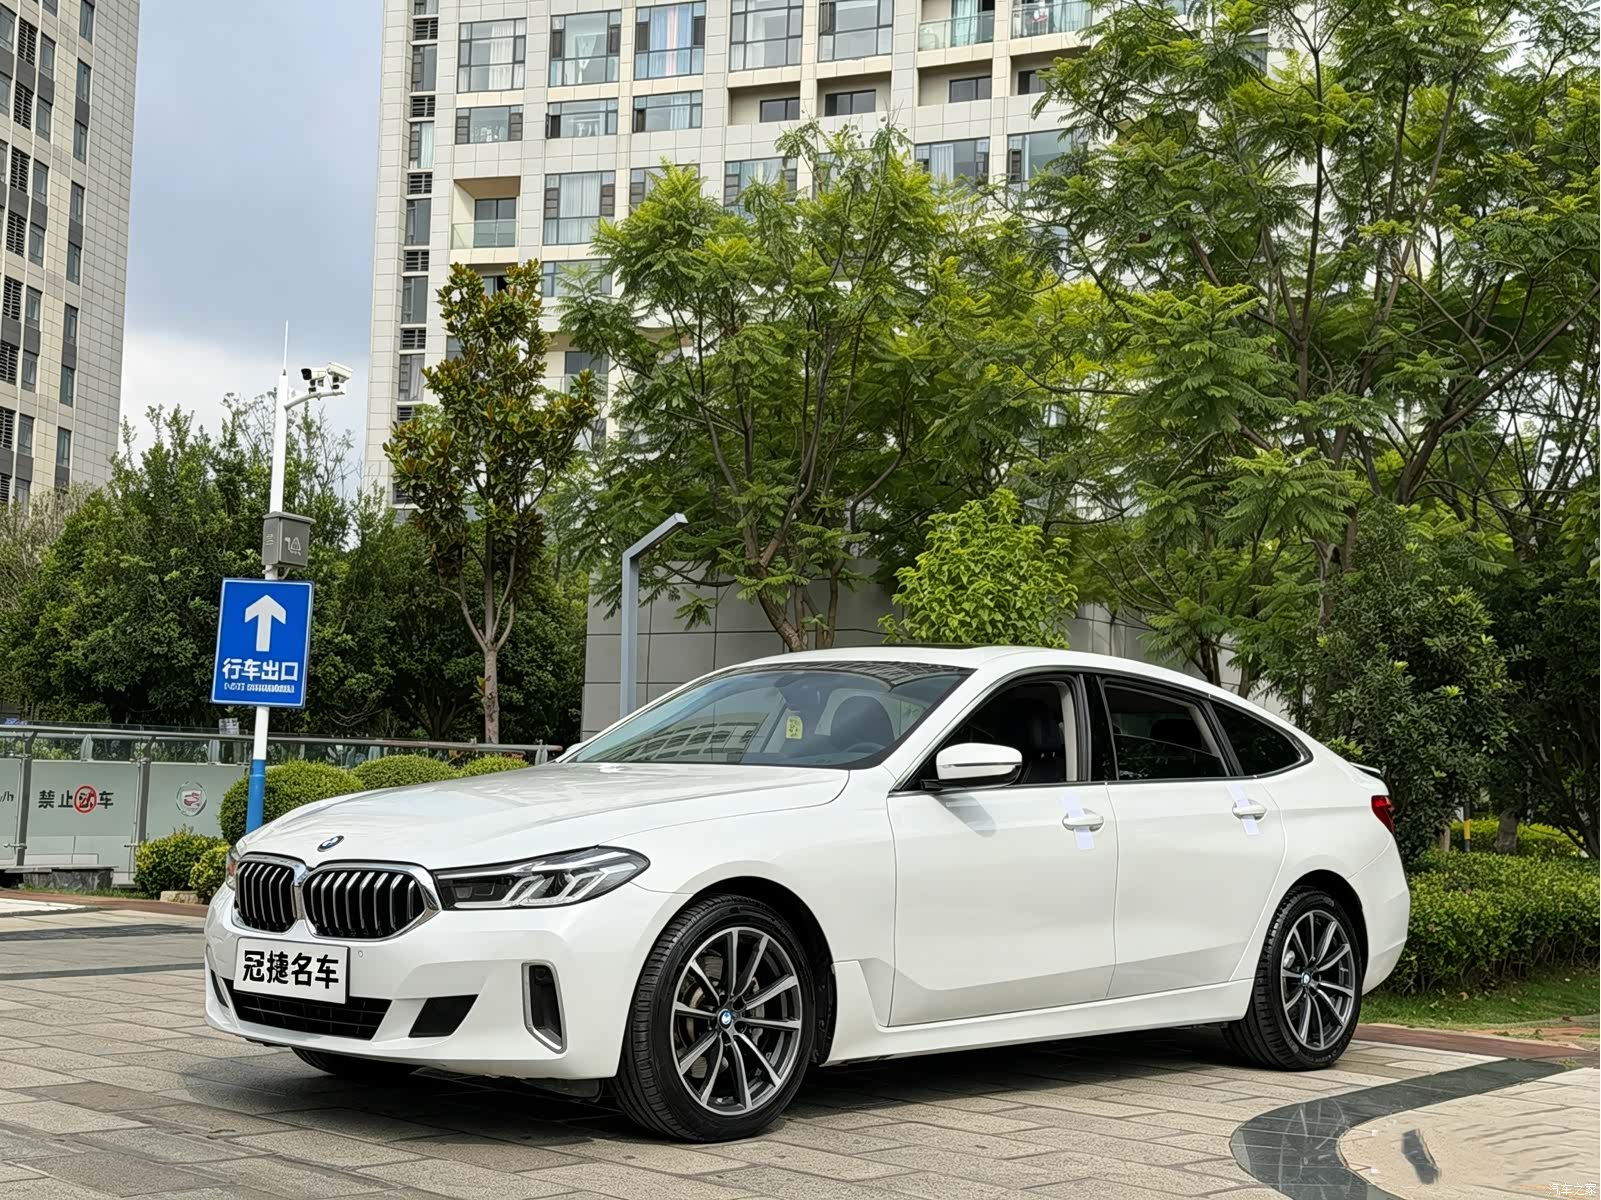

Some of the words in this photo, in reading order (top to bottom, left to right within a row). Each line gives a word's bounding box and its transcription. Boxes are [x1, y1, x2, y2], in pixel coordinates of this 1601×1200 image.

[222, 657, 299, 681] 行车出口
[242, 950, 339, 989] 冠捷名车
